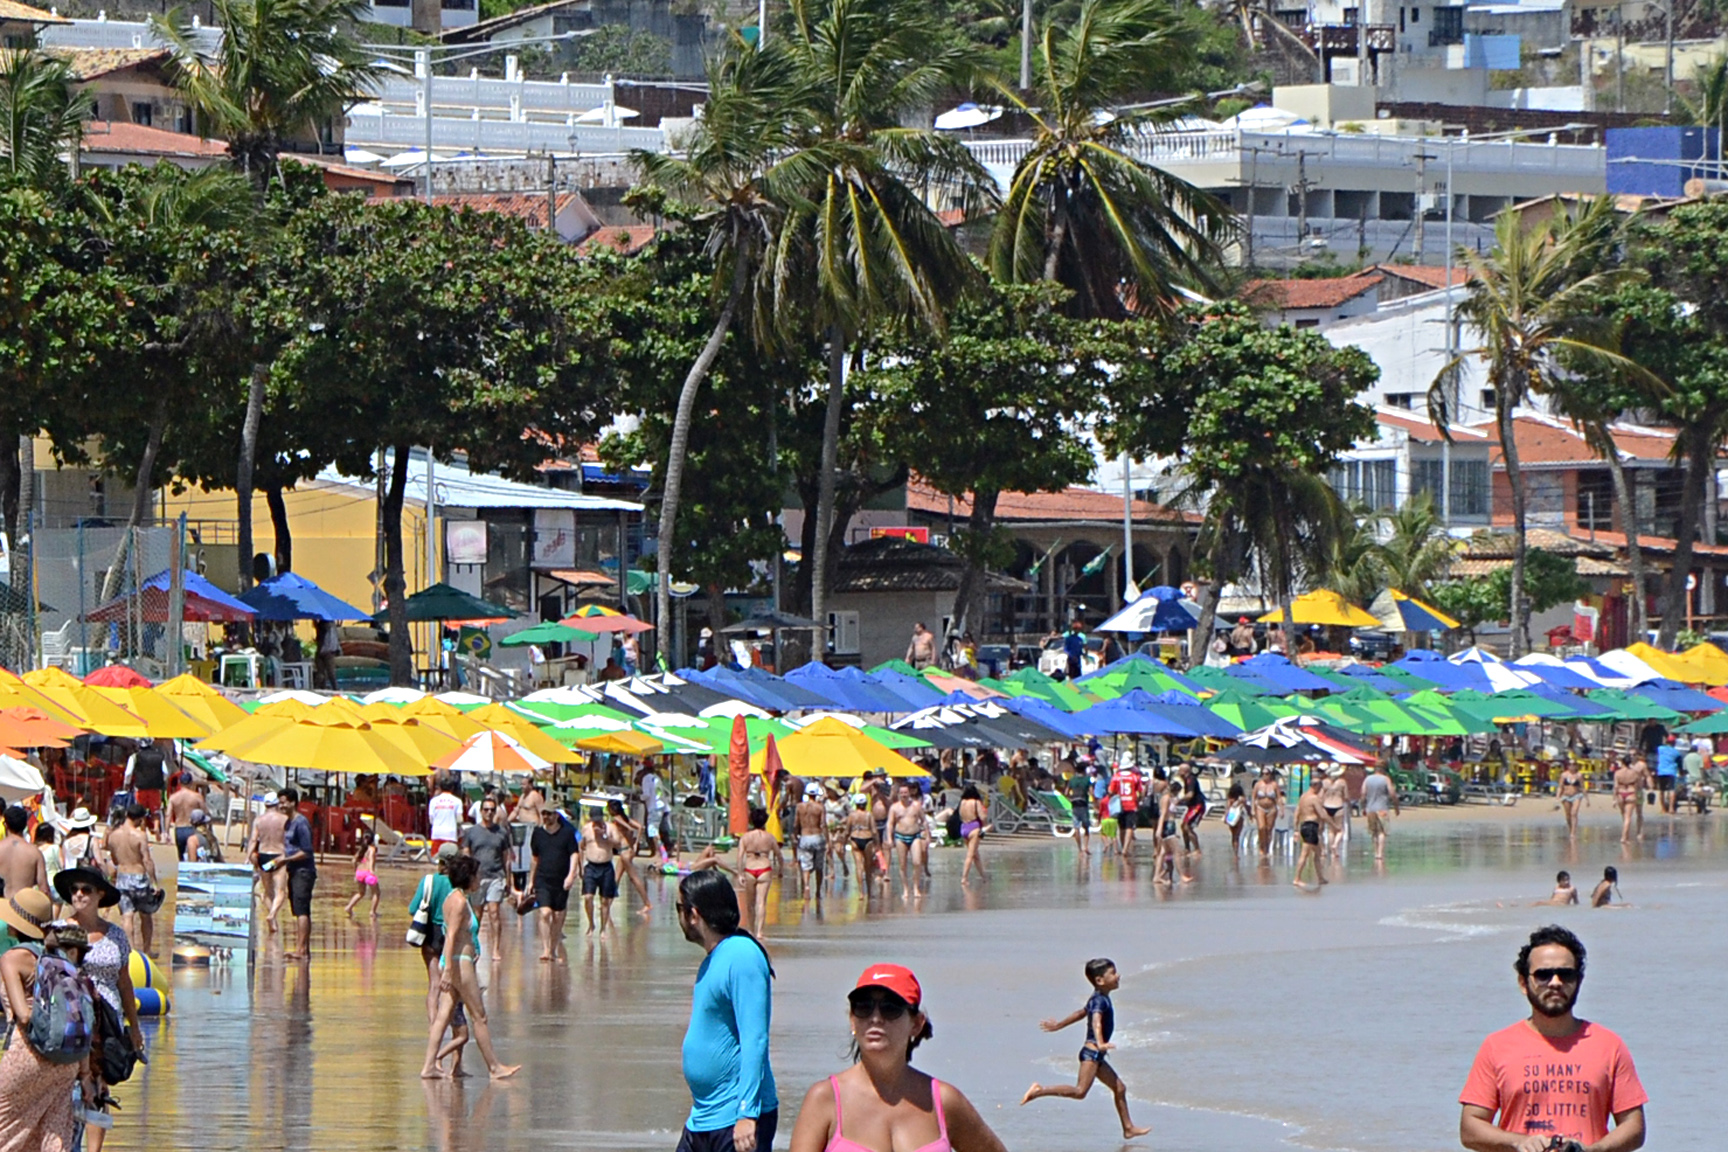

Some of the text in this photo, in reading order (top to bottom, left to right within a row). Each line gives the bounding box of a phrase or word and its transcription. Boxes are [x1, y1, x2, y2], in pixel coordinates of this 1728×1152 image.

[1546, 1063, 1582, 1077] MANY
[1523, 1079, 1591, 1094] CONCERTS
[1525, 1103, 1587, 1118] SO LITTLE
